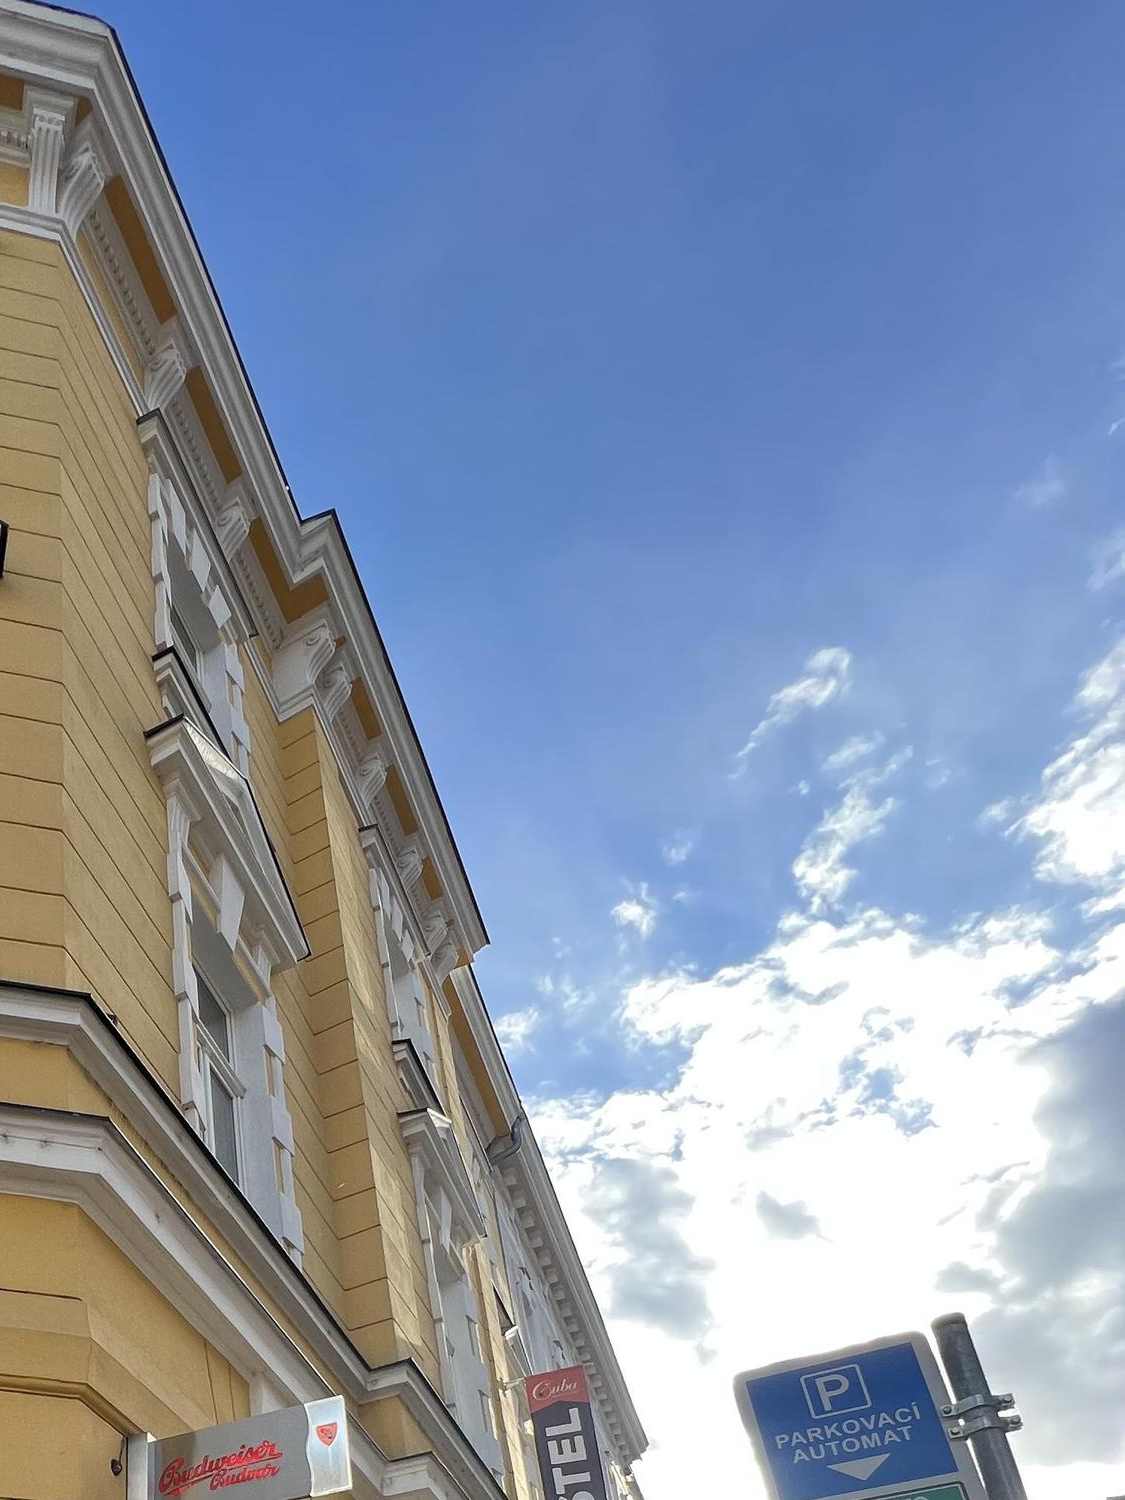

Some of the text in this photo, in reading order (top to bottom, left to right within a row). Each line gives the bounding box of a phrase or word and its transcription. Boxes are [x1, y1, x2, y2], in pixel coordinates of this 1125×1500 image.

[814, 1373, 850, 1411] P
[775, 1402, 922, 1450] PARKOVACÍ
[793, 1426, 912, 1463] AUTOMAT
[159, 1440, 283, 1496] Budweiser
